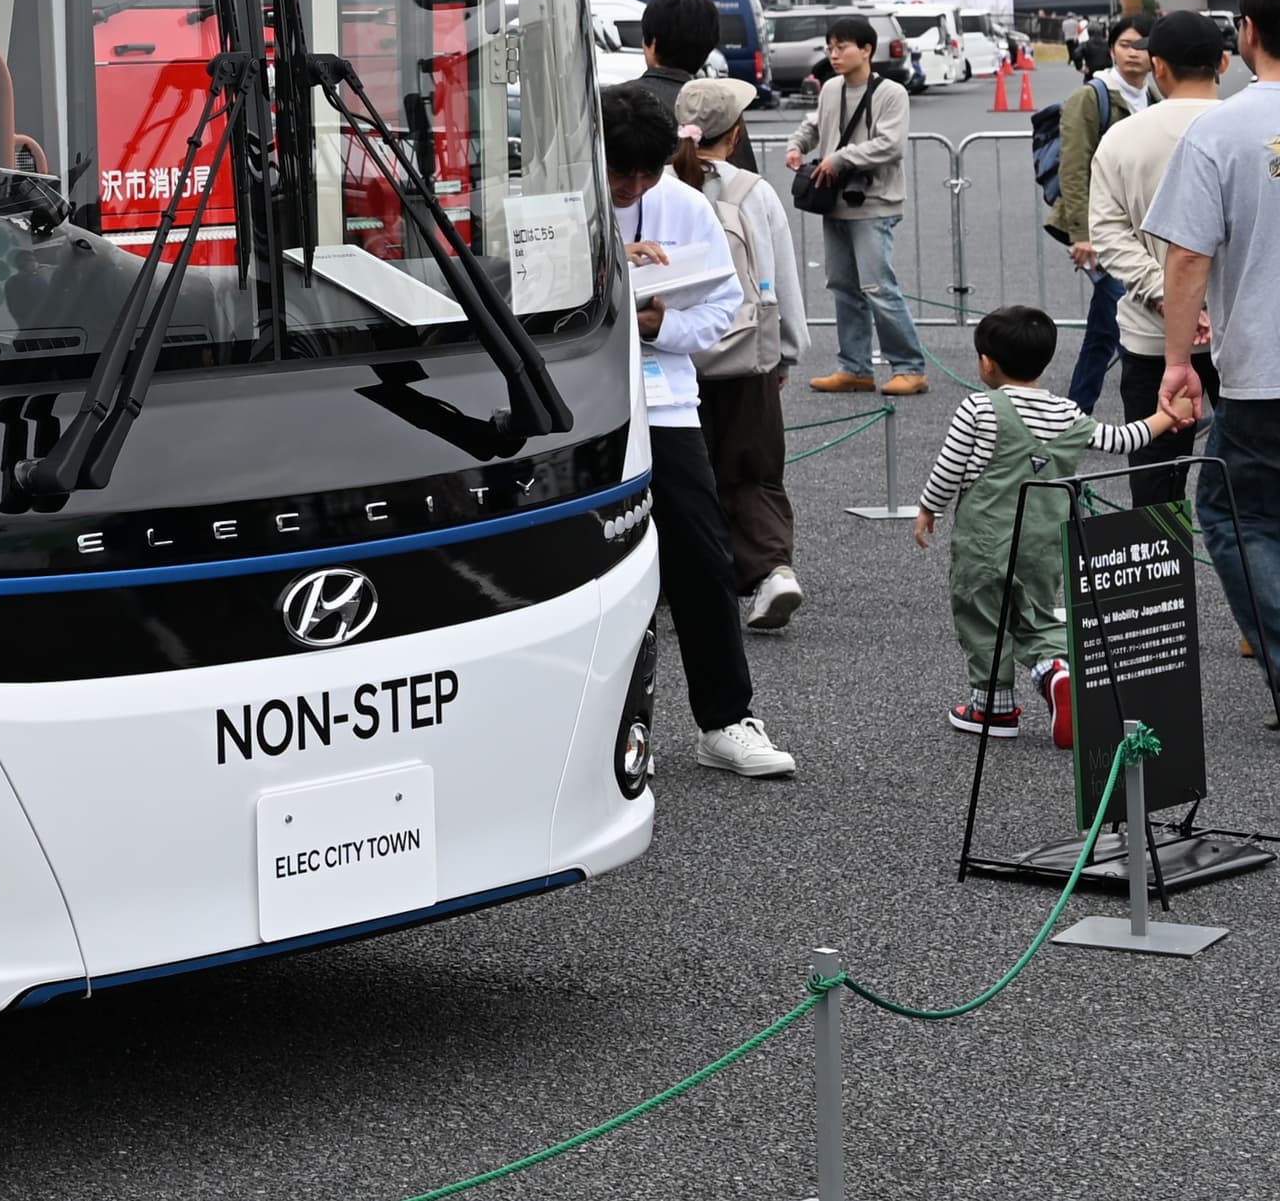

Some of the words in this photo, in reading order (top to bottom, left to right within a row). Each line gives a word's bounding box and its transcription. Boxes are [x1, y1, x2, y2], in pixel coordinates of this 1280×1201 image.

[76, 512, 301, 554] ELEC
[364, 477, 536, 521] CITY
[1080, 572, 1111, 593] EEC
[1114, 566, 1142, 586] CITY
[1146, 559, 1180, 580] TOWN
[1082, 613, 1111, 629] Hyunai
[216, 669, 459, 765] NON-STEP
[275, 850, 320, 879] ELEC
[324, 840, 364, 868] CITY
[366, 828, 421, 859] TOWN
